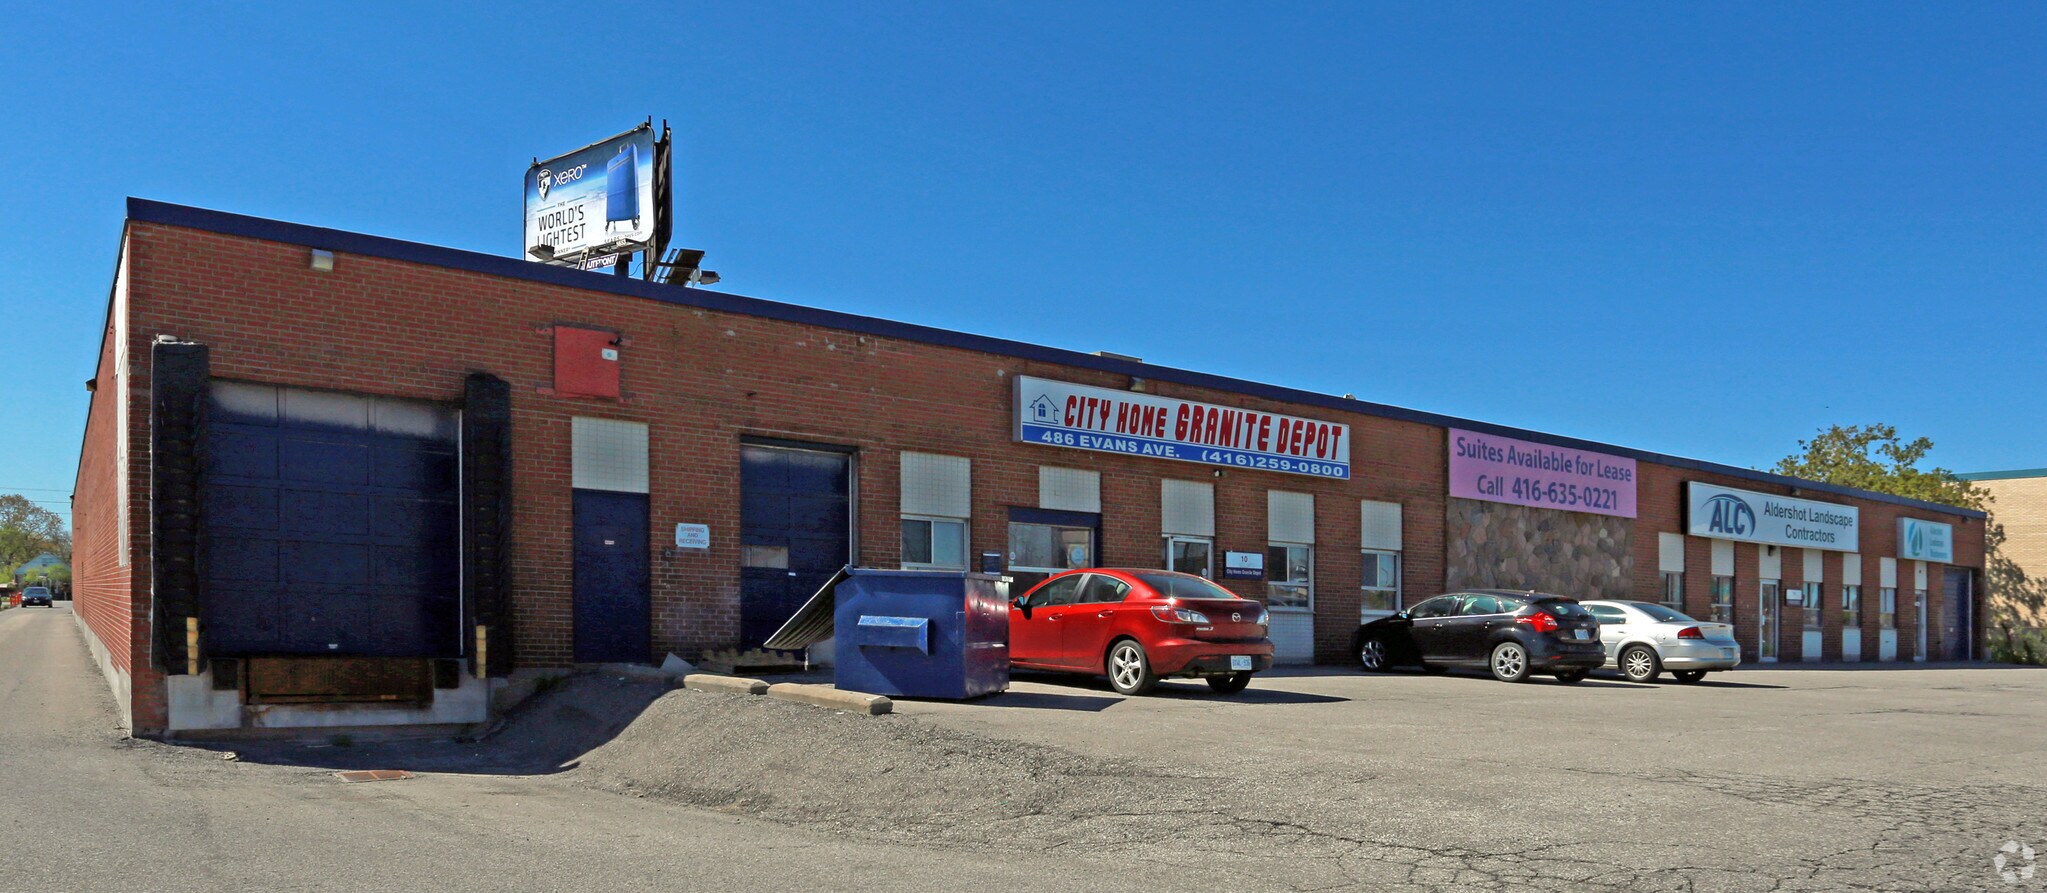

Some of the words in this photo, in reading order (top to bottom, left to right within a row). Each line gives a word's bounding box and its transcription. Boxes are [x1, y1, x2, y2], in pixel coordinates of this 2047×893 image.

[537, 223, 586, 247] LIGHTEST
[538, 204, 585, 232] WORLD'S
[1064, 395, 1111, 431] CITY
[1116, 401, 1167, 438] HOME
[1175, 403, 1271, 451] GRANITE
[1276, 418, 1342, 460] DEPOT
[1041, 430, 1075, 446] 486
[1079, 435, 1138, 453] EVANS
[1142, 443, 1180, 458] AVE.
[1201, 450, 1343, 477] (416)259-0800
[1456, 436, 1503, 463] Suites
[1507, 445, 1573, 473] Available
[1575, 455, 1594, 476] for
[1597, 460, 1632, 482] Lease
[1477, 474, 1503, 497] Call
[1512, 477, 1617, 510] 416-635-0221
[1708, 499, 1746, 535] ALC
[1764, 501, 1807, 521] Aldershot
[1809, 508, 1853, 530] Landscape
[1785, 524, 1835, 543] Contractors
